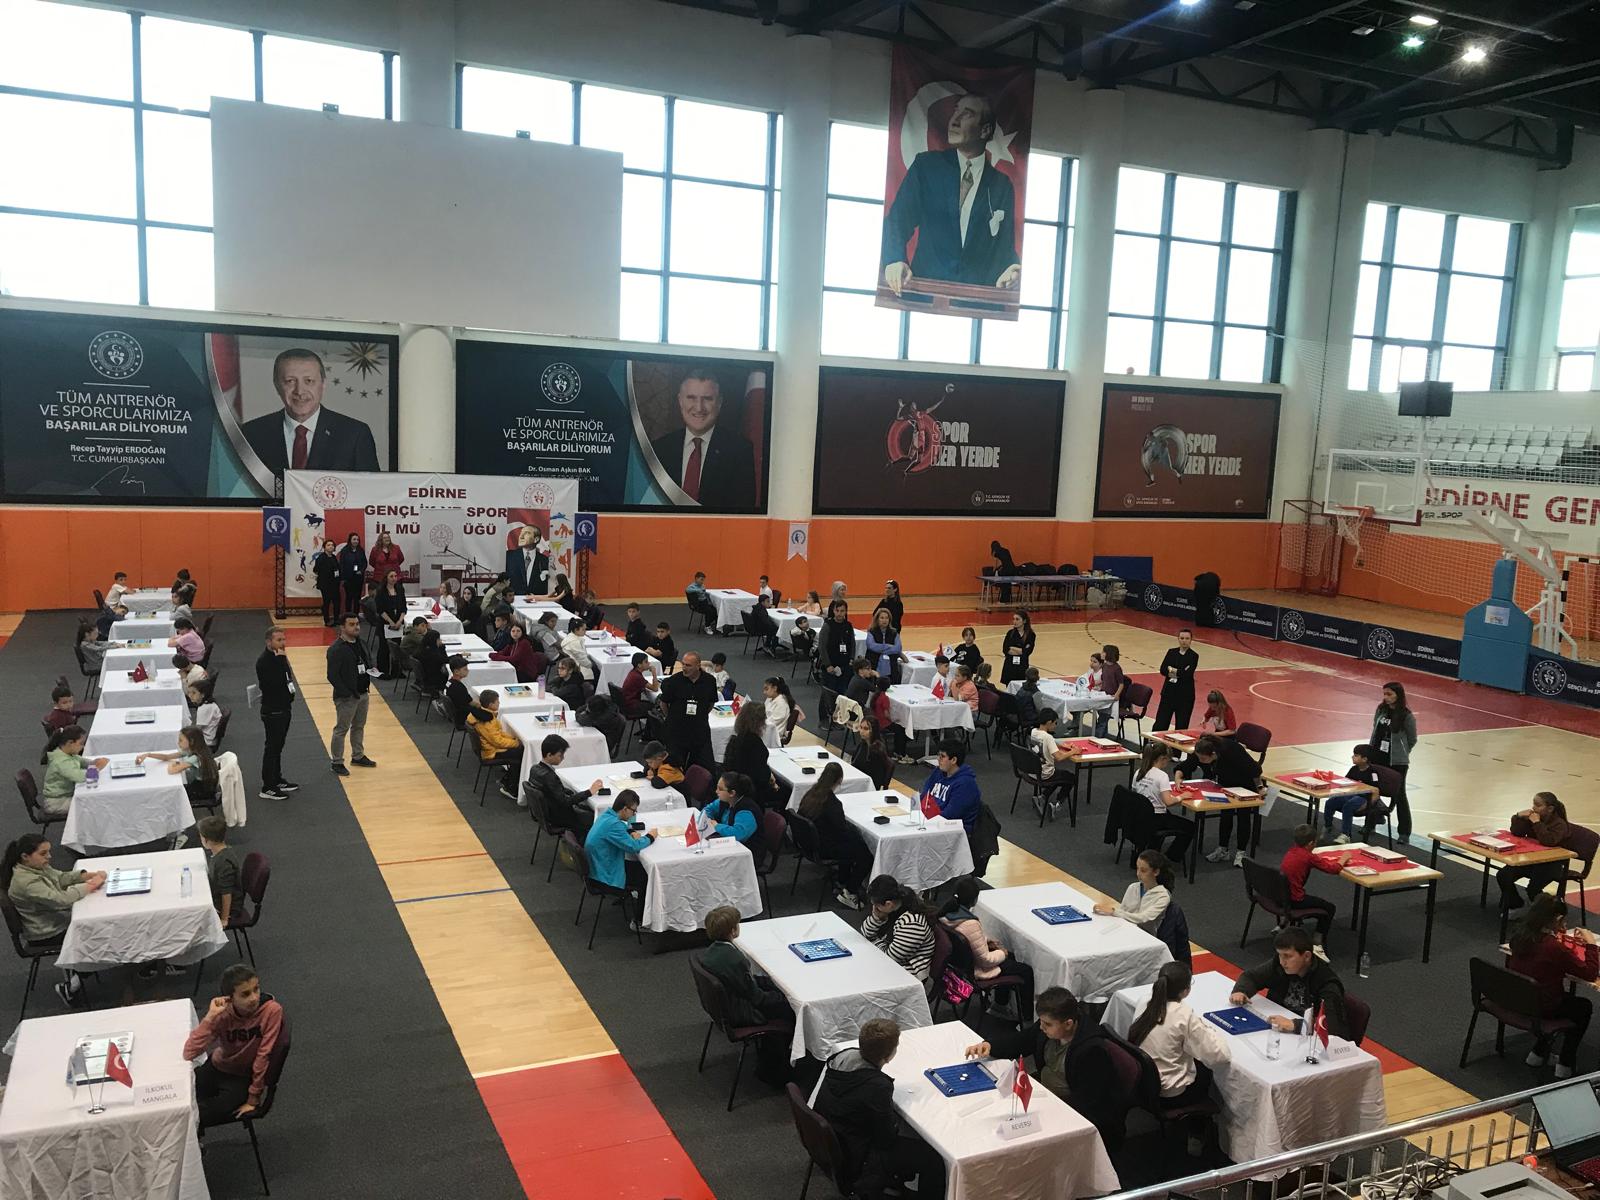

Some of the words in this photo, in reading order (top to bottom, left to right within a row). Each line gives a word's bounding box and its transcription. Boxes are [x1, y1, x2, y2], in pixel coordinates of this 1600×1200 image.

[56, 389, 92, 404] TÜM
[96, 393, 176, 408] ANTRENÖR
[39, 404, 59, 416] VE
[62, 405, 192, 422] SPORCULARIMIZA
[46, 420, 117, 432] BAŞARILAR
[119, 421, 188, 434] DİLİYORUM
[516, 416, 541, 428] TÜM
[544, 418, 604, 431] ANTRENÖR
[503, 428, 517, 439] VE
[519, 429, 615, 443] SPORCULARIMIZA
[931, 420, 970, 443] SPOR
[70, 444, 96, 453] Recep
[97, 445, 124, 454] Tayyip
[125, 445, 166, 454] ERDOĞAN
[507, 441, 559, 453] BAŞARILAR
[560, 442, 612, 454] DİLİYORUM
[1185, 432, 1217, 454] SPOR
[71, 454, 88, 463] T.C.
[88, 455, 165, 466] CUMHURBAŞKANI
[959, 446, 1000, 468] YERDE
[1208, 456, 1242, 476] YERDE
[408, 485, 467, 499] EDİRNE
[466, 506, 507, 518] SPOR
